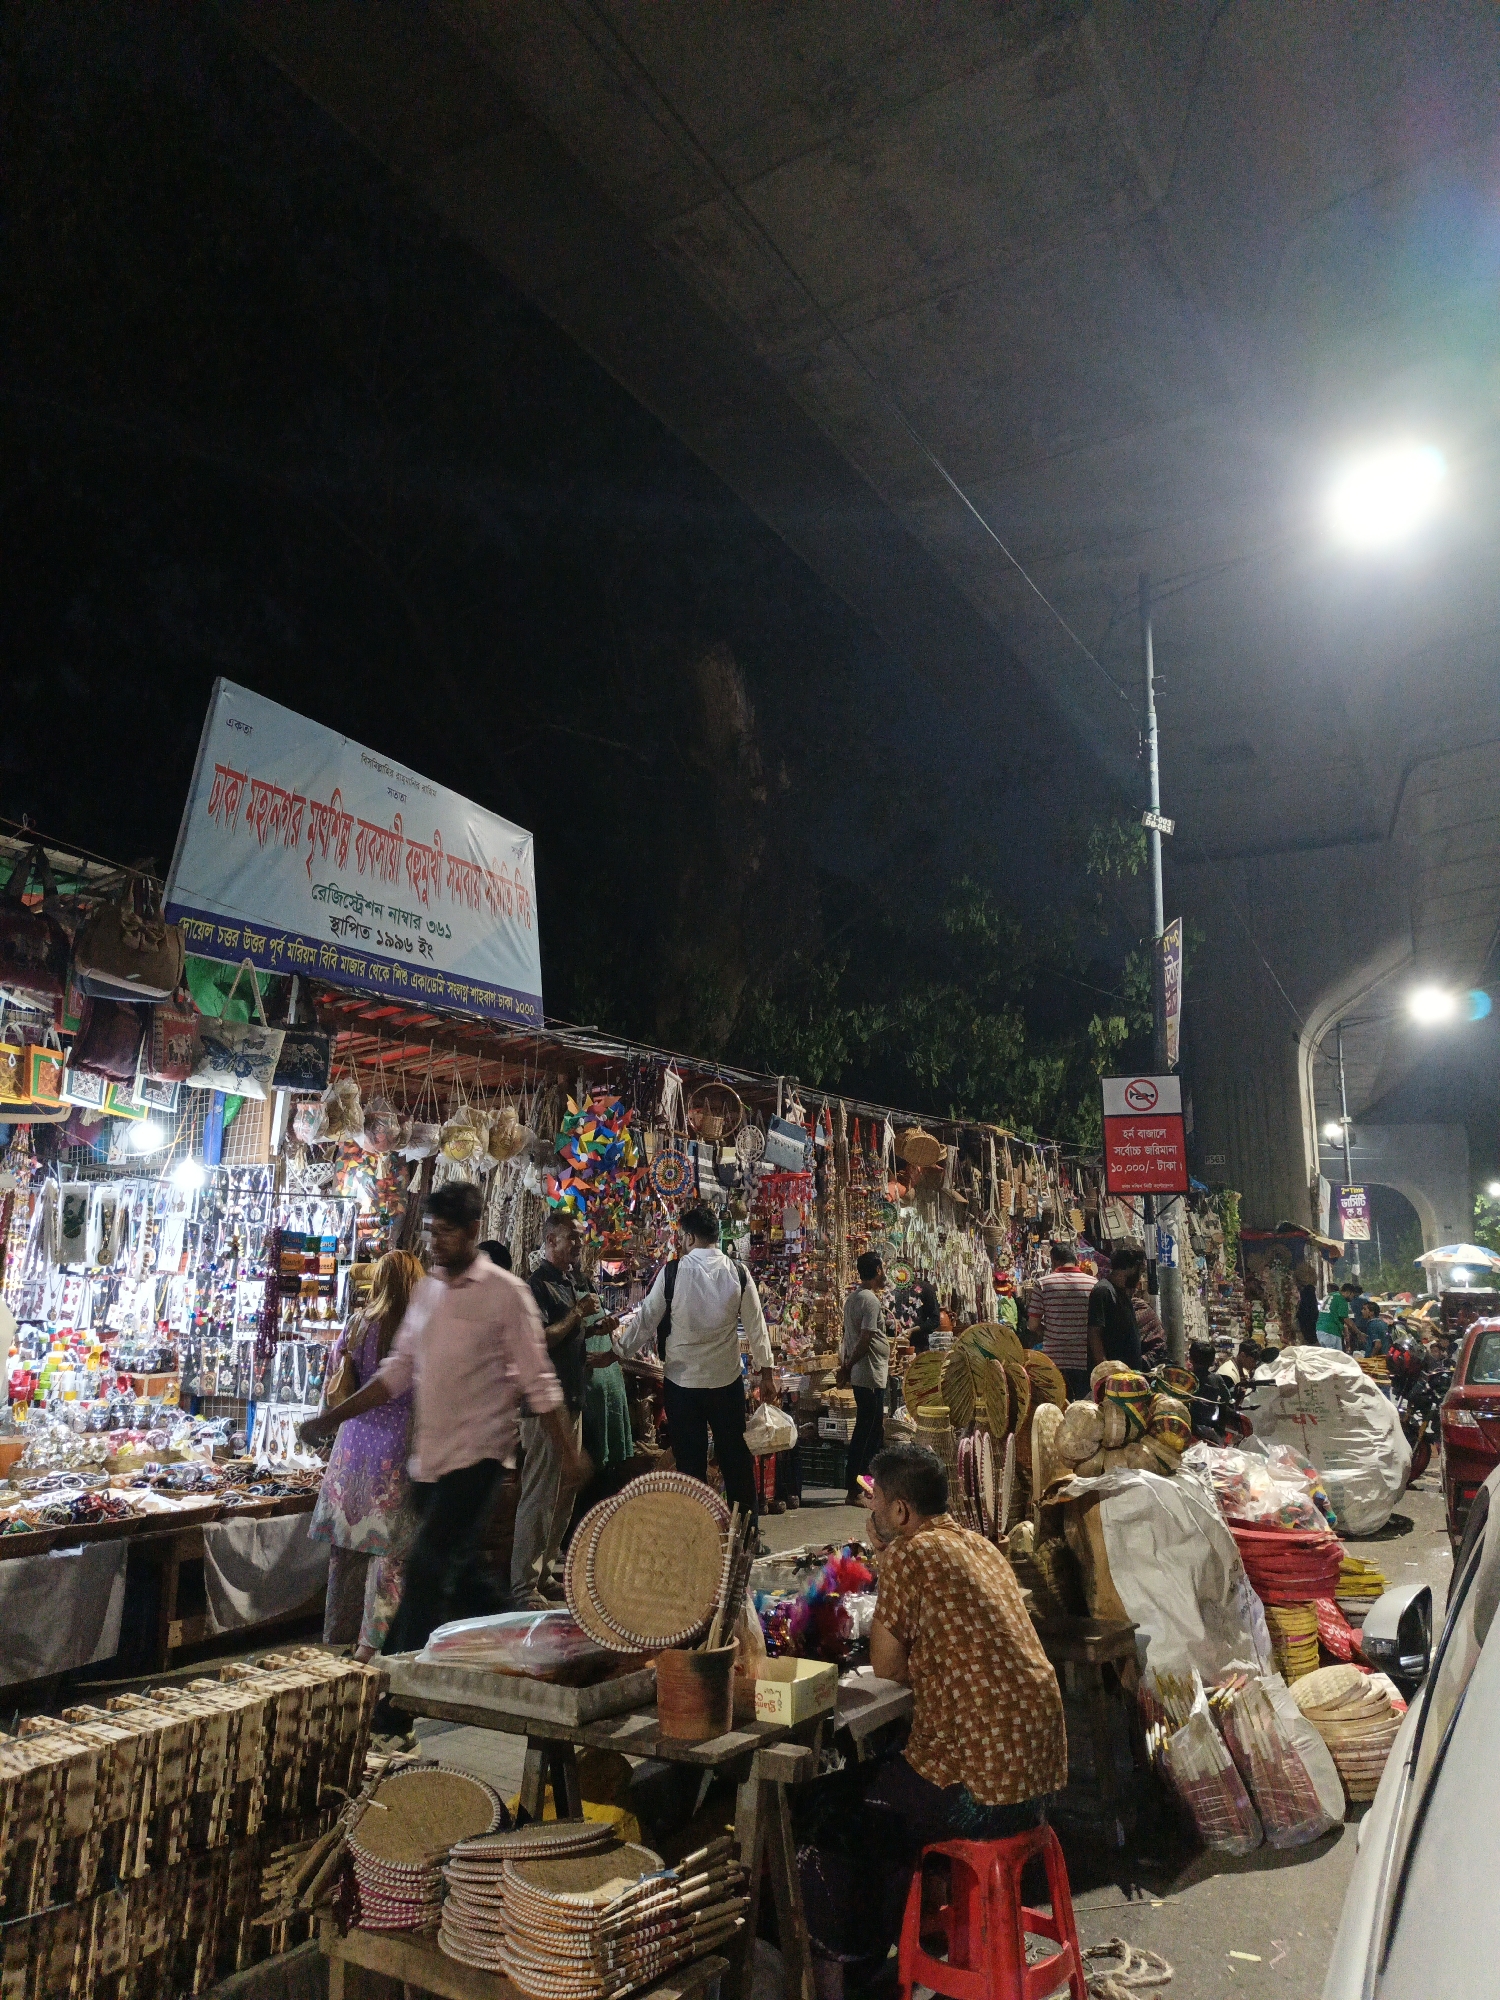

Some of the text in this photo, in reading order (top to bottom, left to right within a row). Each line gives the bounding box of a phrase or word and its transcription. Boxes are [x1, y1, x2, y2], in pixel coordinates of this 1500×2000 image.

[207, 760, 248, 836] ঢাকা
[246, 778, 306, 851] মহানগর
[355, 812, 404, 887] ব্যবসায়ী
[405, 829, 444, 911] বহুমুখী
[446, 853, 482, 914] সমবায়
[312, 883, 452, 939] রেজিস্ট্রেশন নাম্বার ৩৬১
[243, 925, 267, 954] উত্তর
[270, 935, 287, 966] পূর্ব
[288, 938, 317, 966] মরিয়ম
[319, 944, 339, 971] বিবি
[340, 956, 367, 978] মাজার
[369, 963, 390, 983] থেকে
[410, 973, 446, 996] একাডেমি
[329, 915, 434, 962] স্থাপিত ১৯৯৬ ইং
[1113, 1142, 1178, 1156] সর্বোচ্চ জরিমানা
[1122, 1127, 1167, 1139] হর্ন বাজালে
